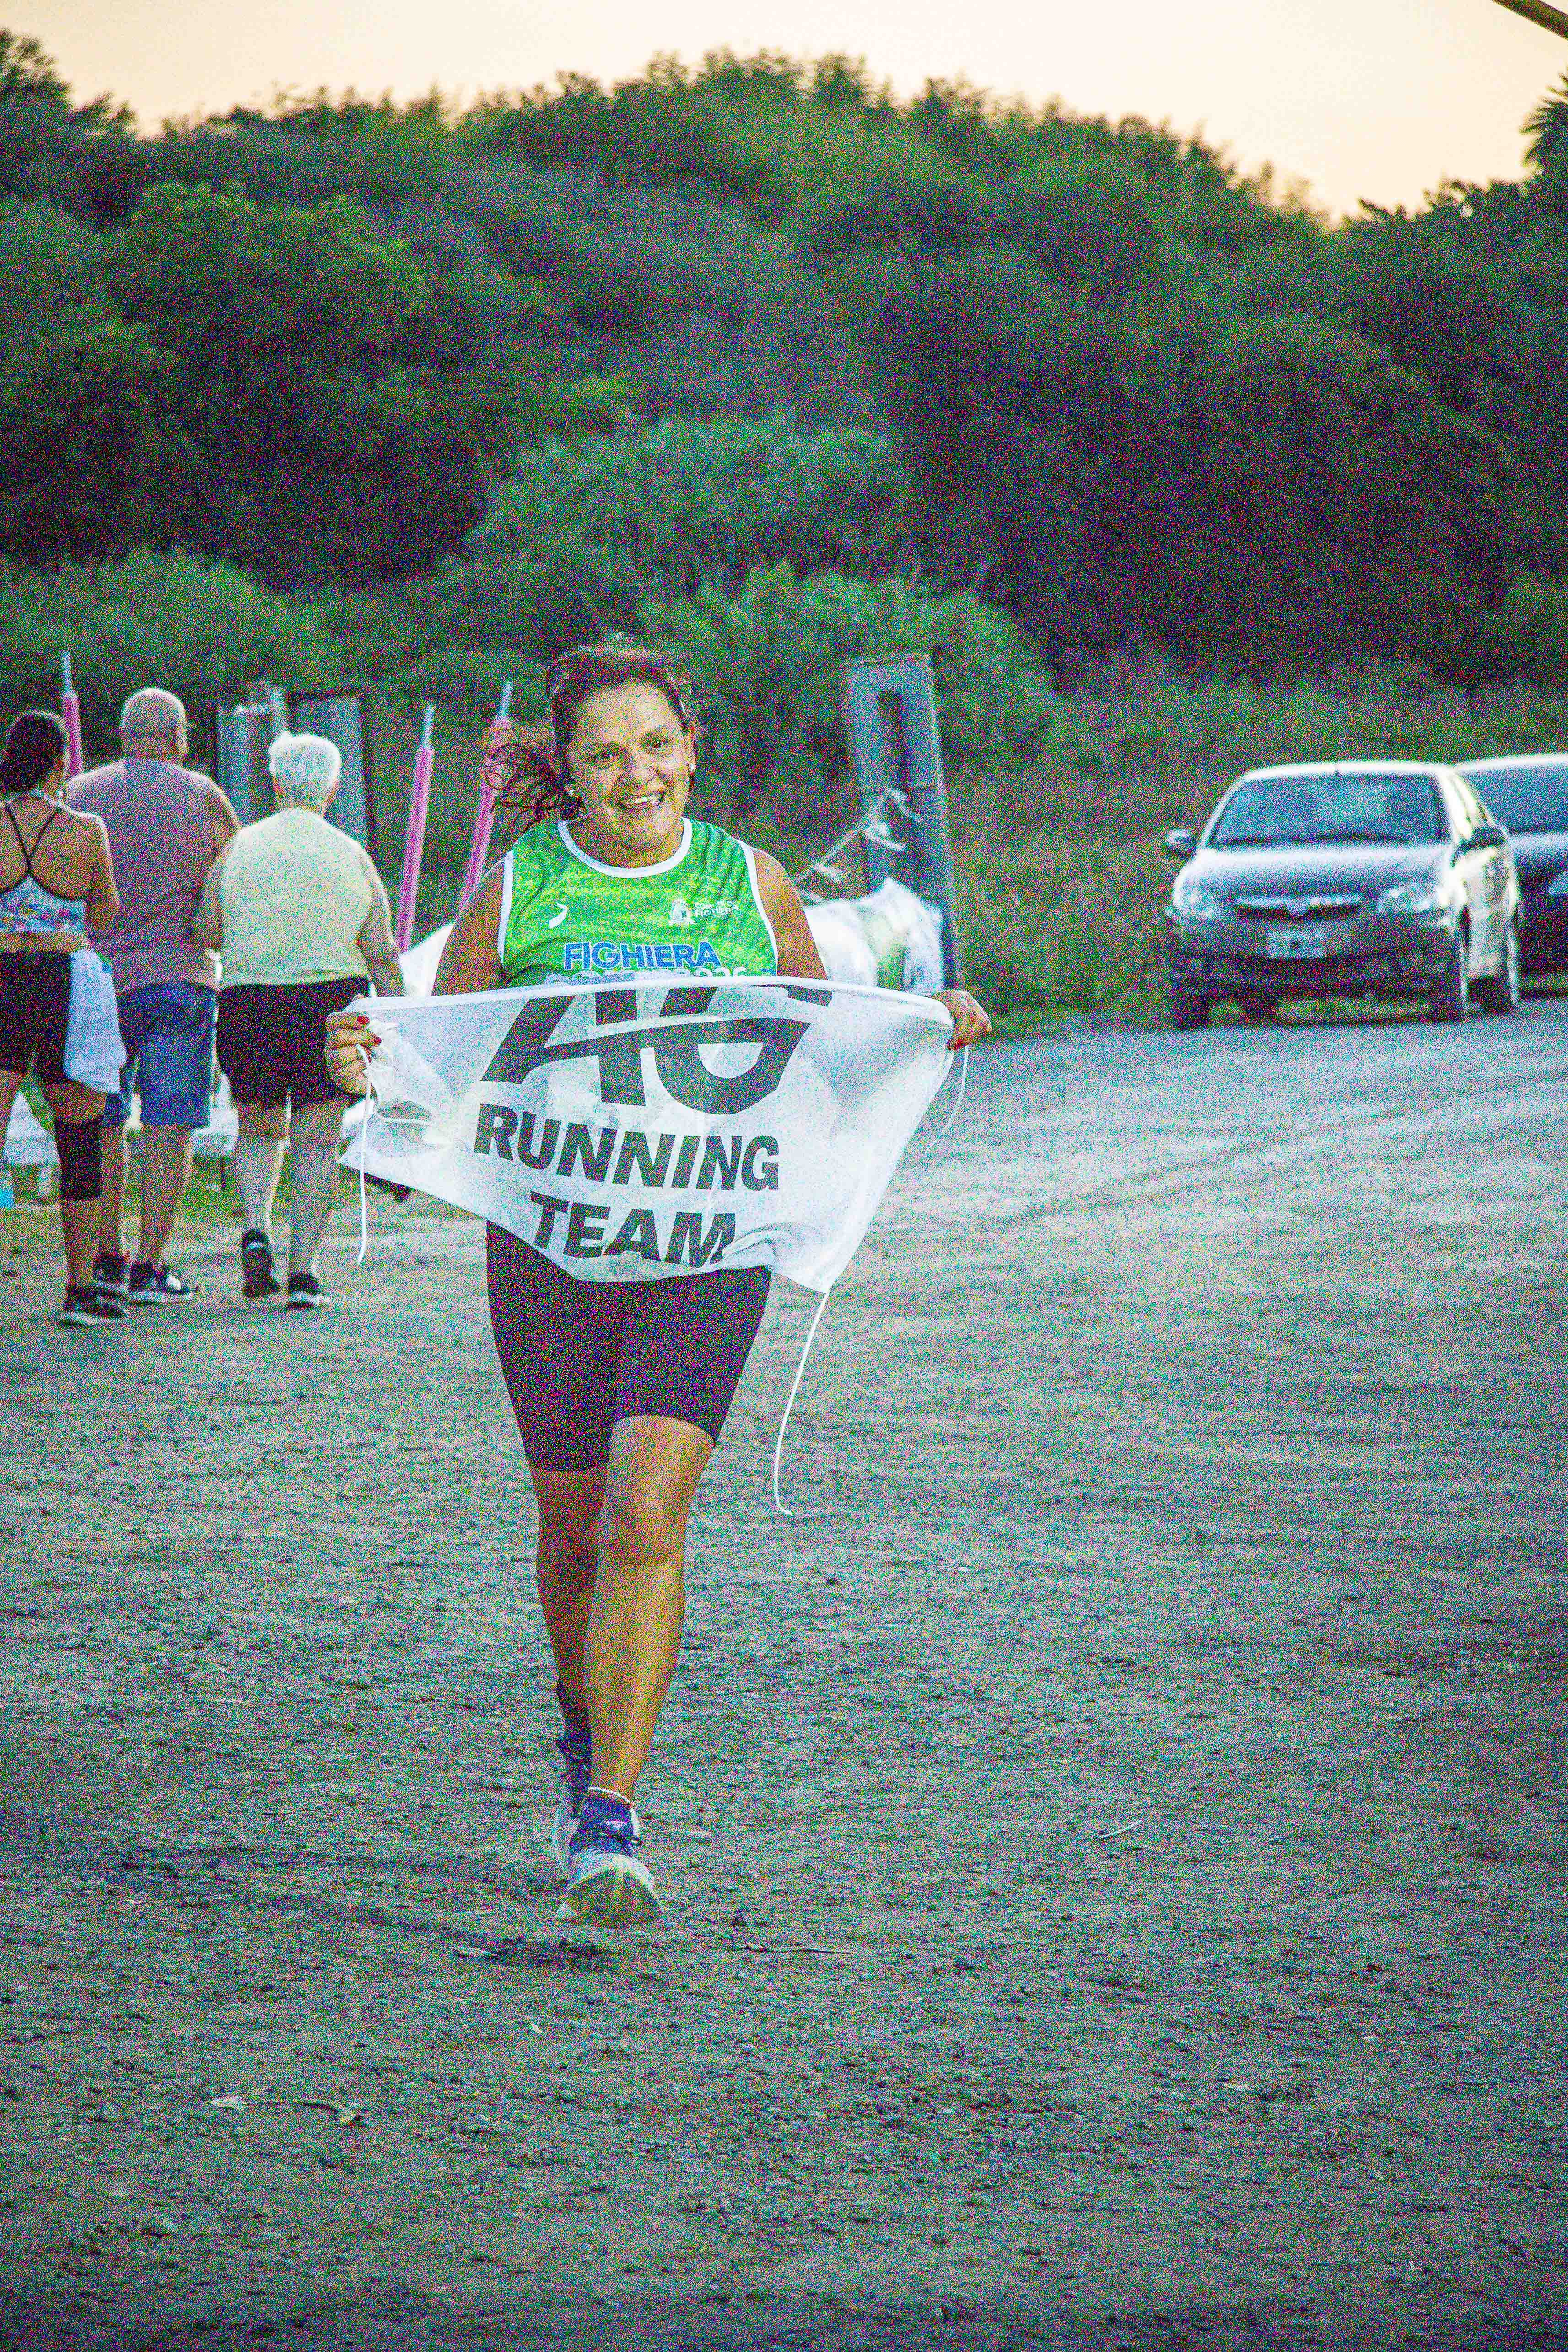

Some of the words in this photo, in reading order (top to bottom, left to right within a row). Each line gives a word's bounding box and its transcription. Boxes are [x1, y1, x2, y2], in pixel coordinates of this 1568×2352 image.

[563, 942, 721, 970] FIGHIERA
[474, 1103, 779, 1190] RUNNING
[530, 1191, 736, 1267] TEAM
